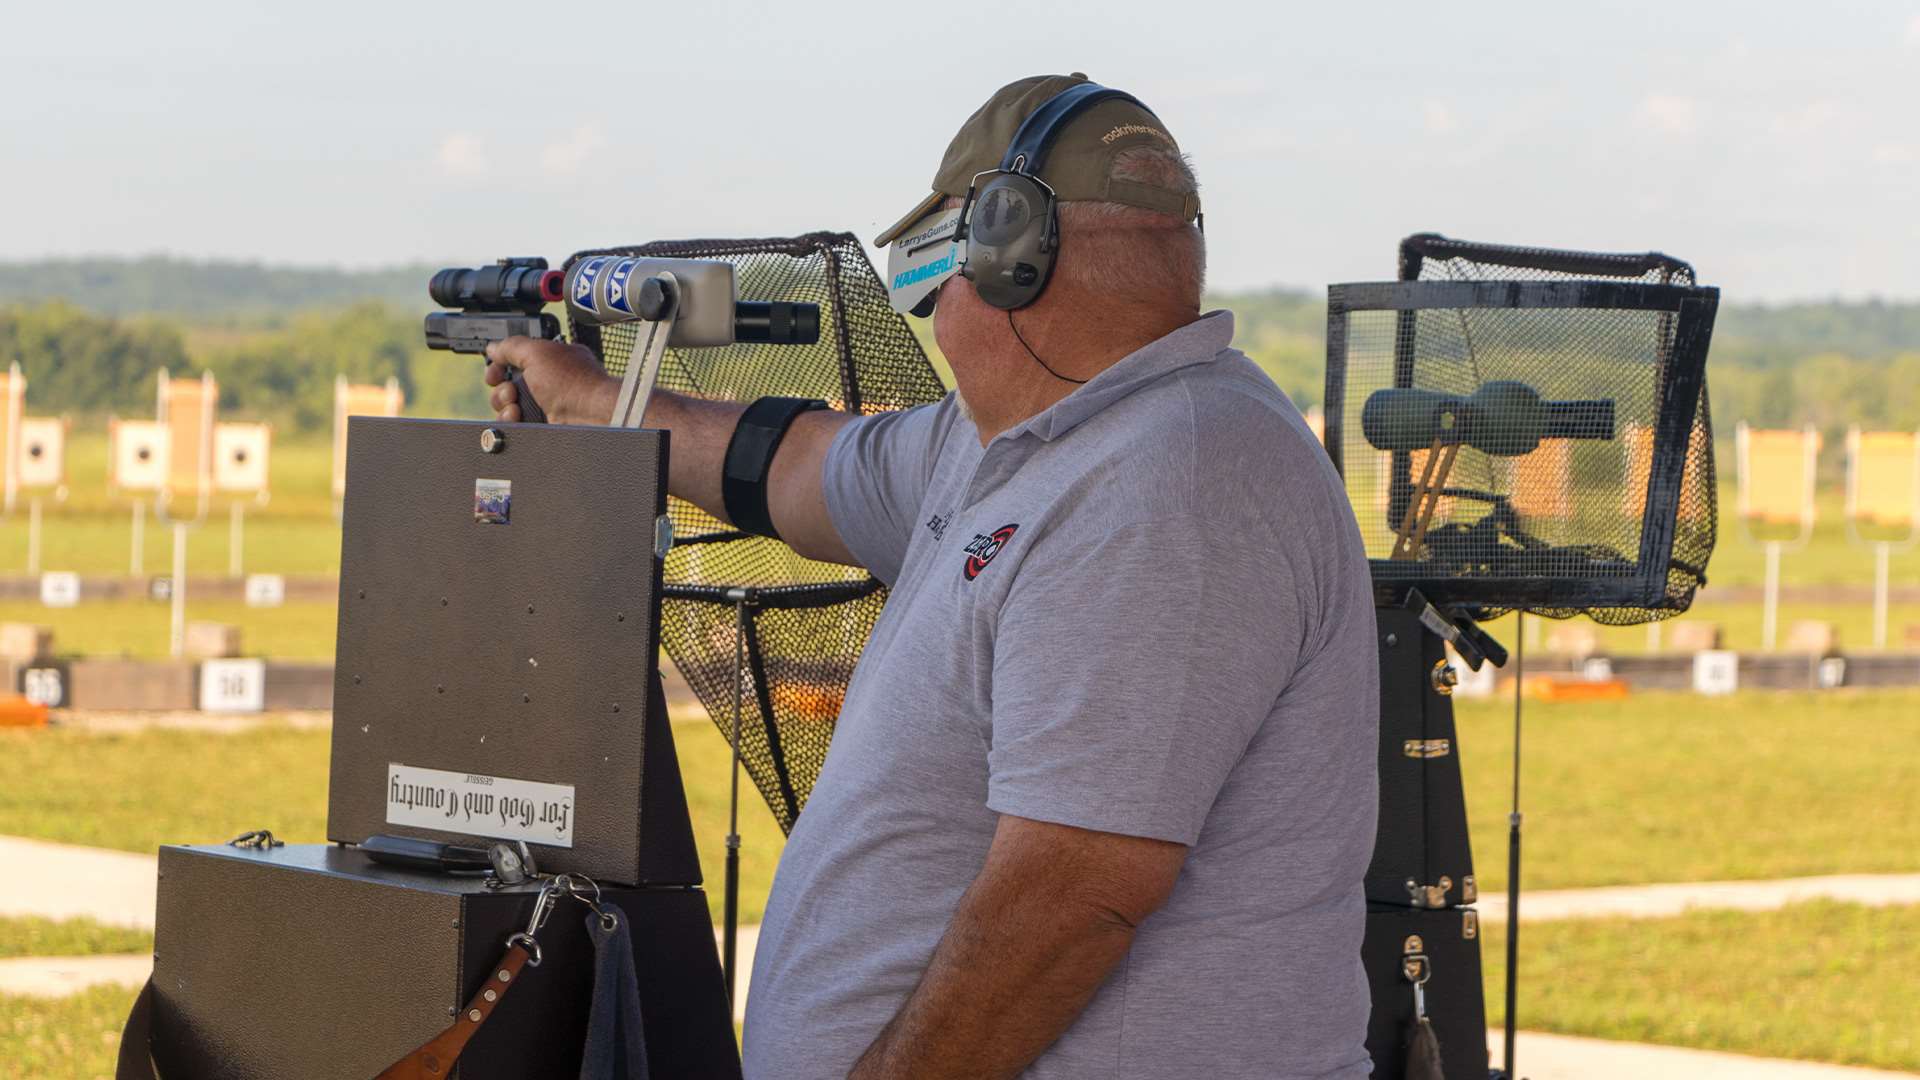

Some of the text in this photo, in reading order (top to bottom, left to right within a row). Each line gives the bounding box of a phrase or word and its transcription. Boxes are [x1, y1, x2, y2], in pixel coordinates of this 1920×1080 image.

[899, 217, 959, 249] LarrysGuns.co
[390, 773, 571, 840] For God and Country
